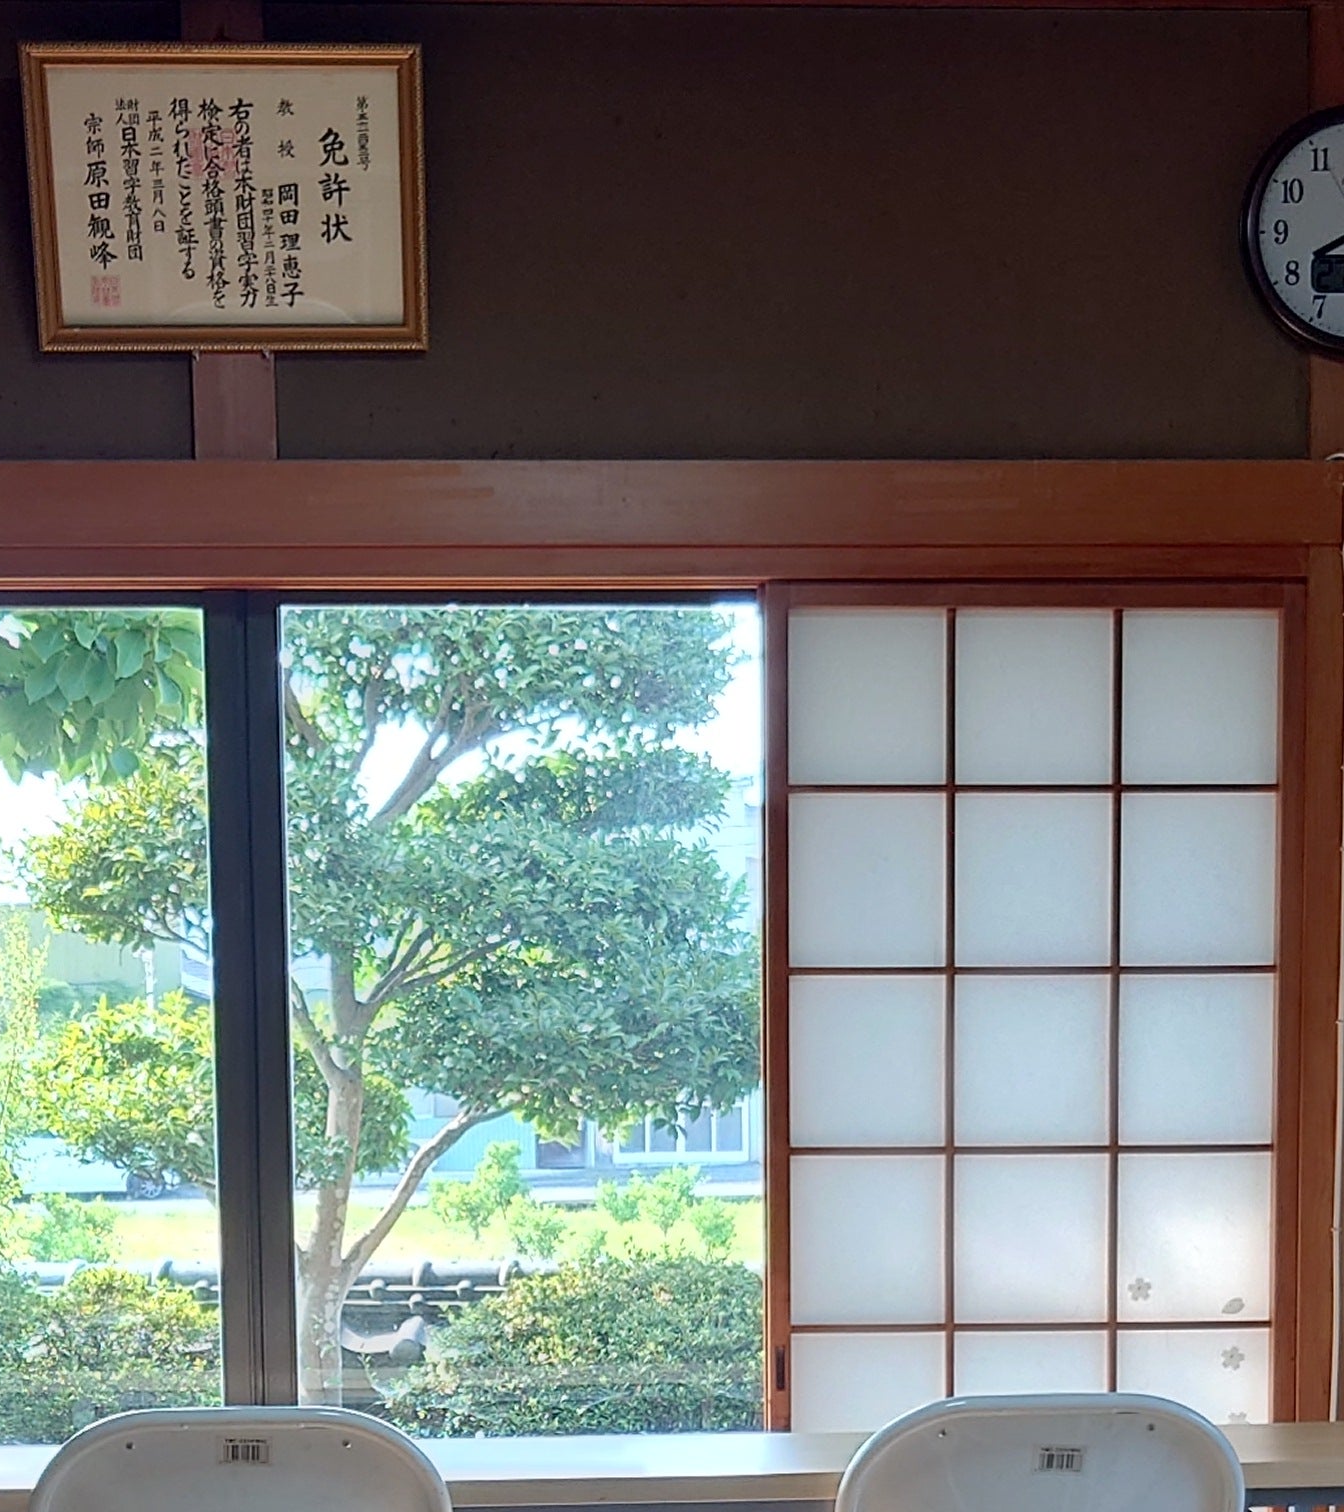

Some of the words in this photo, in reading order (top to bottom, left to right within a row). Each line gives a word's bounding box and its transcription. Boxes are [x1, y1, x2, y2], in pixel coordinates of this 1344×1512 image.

[1311, 147, 1331, 172] 11
[168, 98, 199, 280] 得られたことを証する
[318, 127, 353, 244] 免許状
[1281, 178, 1304, 203] 10
[197, 98, 231, 309] 検定に合格頭書の資格を
[1274, 219, 1289, 244] 9
[277, 183, 304, 308] 岡田理恵子
[1285, 260, 1300, 285] 8
[1312, 294, 1326, 318] 7
